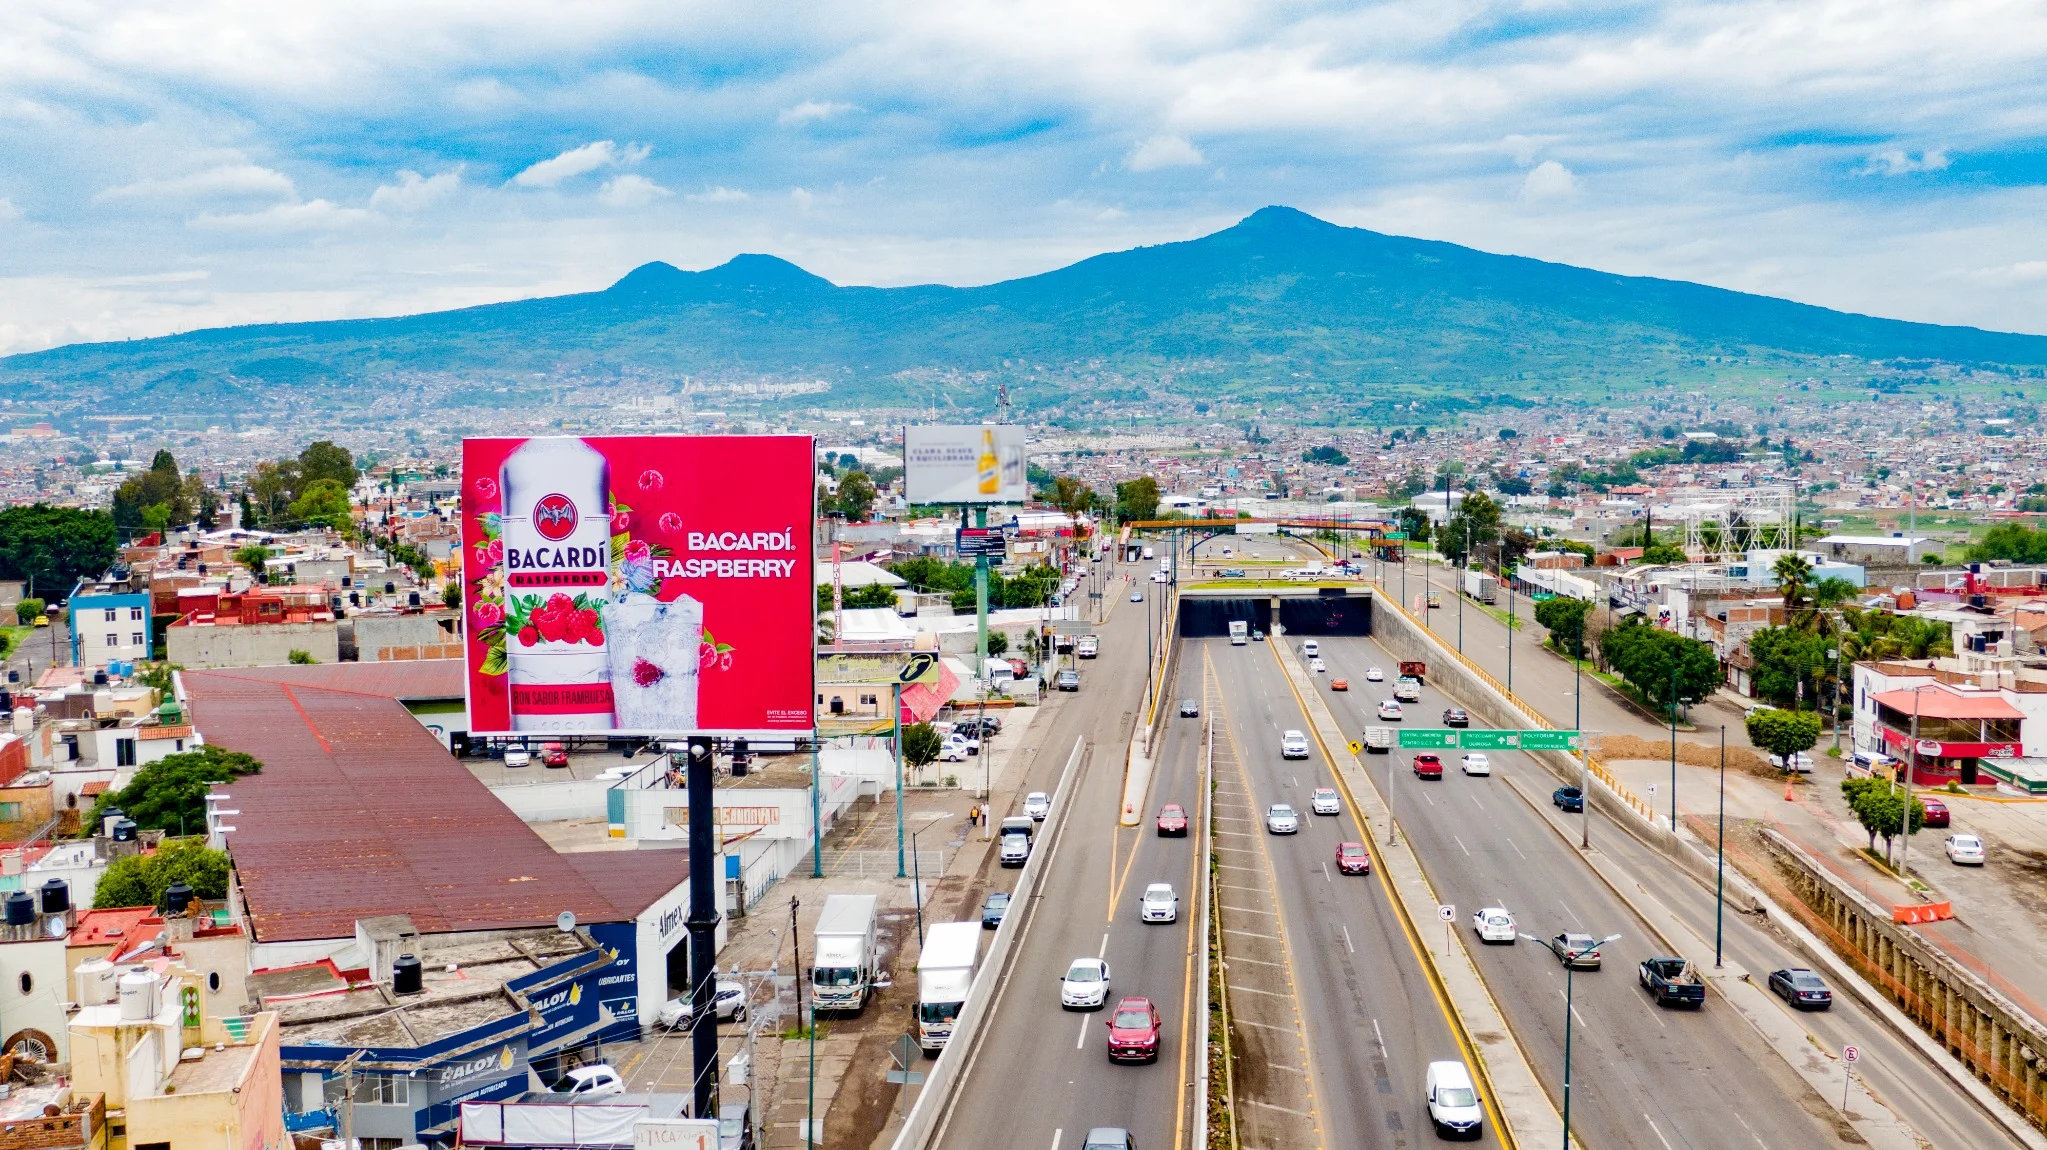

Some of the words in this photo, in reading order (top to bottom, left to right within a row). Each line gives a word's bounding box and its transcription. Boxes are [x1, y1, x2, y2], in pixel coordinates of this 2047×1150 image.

[687, 526, 792, 551] BACARDÍ
[507, 541, 606, 569] BACARDÍ
[652, 558, 796, 578] RASPBERRY
[515, 575, 599, 585] RASPBERRY
[513, 690, 531, 705] RON
[531, 690, 560, 706] SABOR
[561, 689, 611, 705] FRAMBUESA
[598, 974, 635, 986] UBRICANTES
[533, 990, 568, 1011] ALOY
